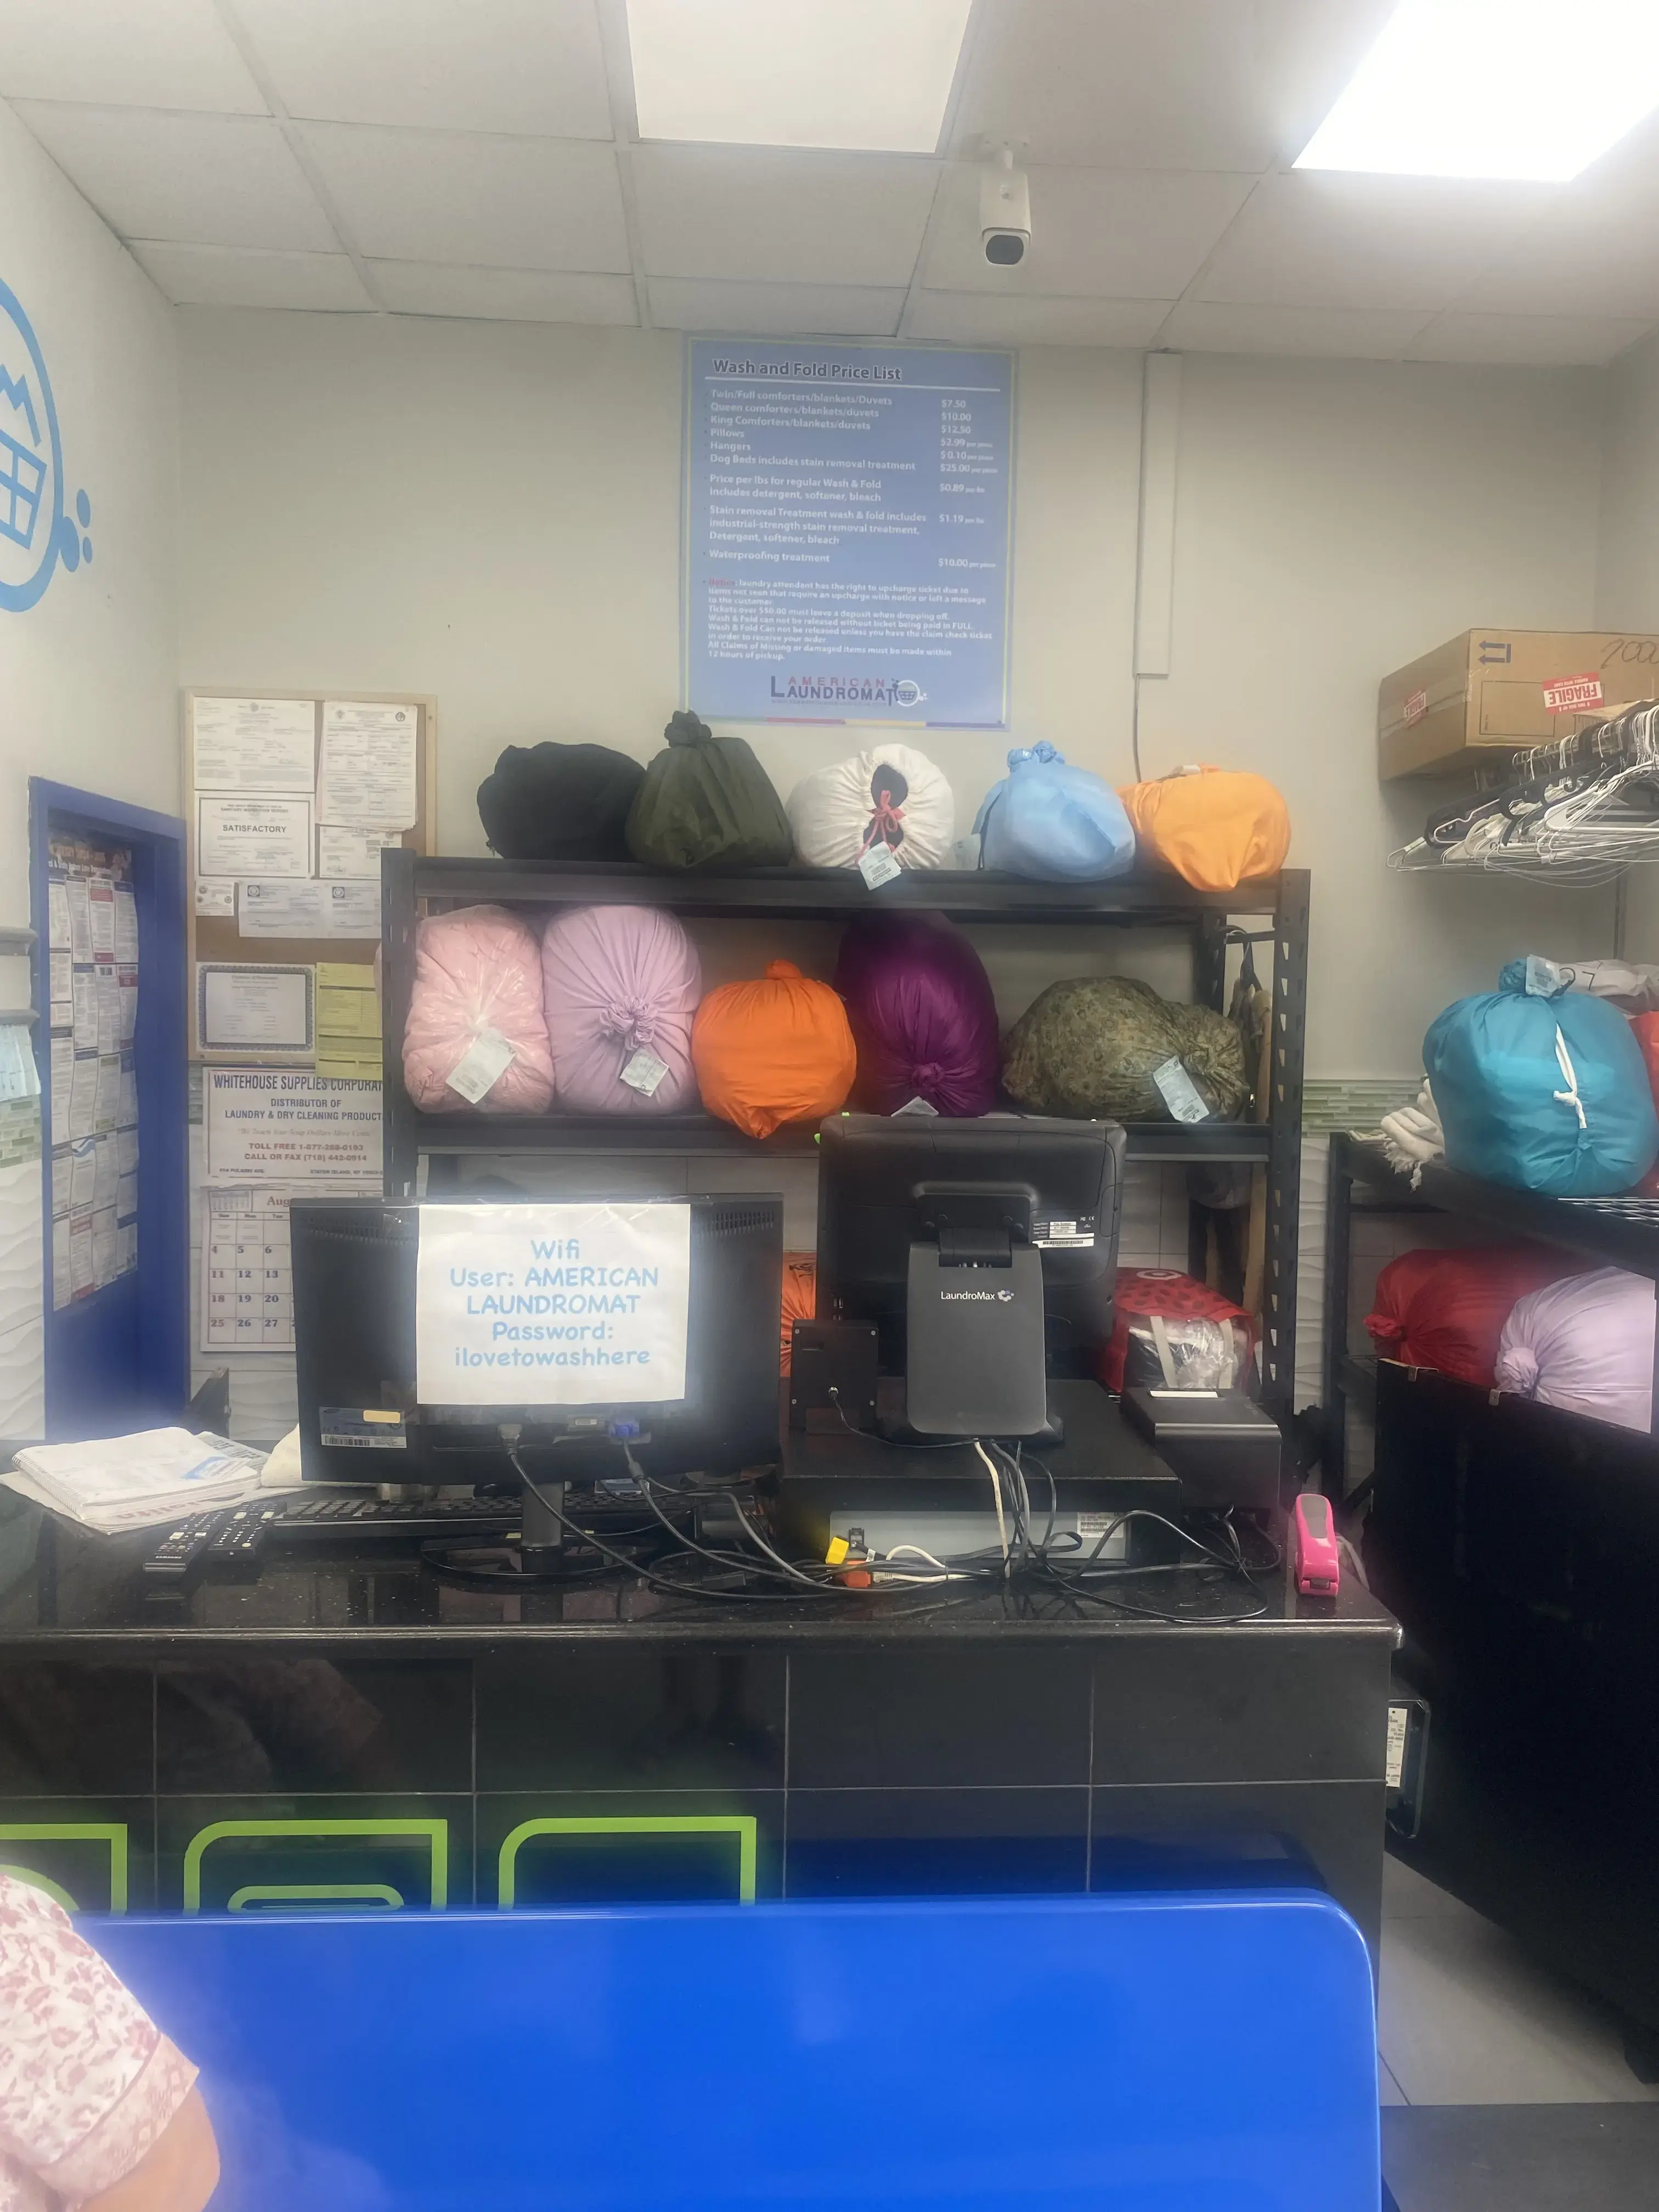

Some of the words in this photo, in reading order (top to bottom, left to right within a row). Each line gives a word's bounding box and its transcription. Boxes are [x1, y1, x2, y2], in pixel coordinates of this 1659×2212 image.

[713, 359, 755, 374] Wash
[759, 362, 789, 375] and
[793, 363, 827, 377] Fold
[831, 364, 870, 379] Price
[873, 366, 901, 380] List
[711, 402, 742, 412] Queen
[941, 399, 966, 408] $7.50
[710, 415, 733, 426] King
[941, 413, 971, 421] $10.00
[710, 428, 744, 438] Pillows
[941, 426, 970, 434] $12.50
[710, 441, 751, 452] Hangers
[941, 438, 965, 447] $2.99
[710, 453, 730, 465] Dog
[733, 454, 755, 464] Beds
[758, 455, 798, 466] includes
[801, 458, 823, 466] stain
[826, 459, 865, 467] removal
[868, 460, 915, 470] treatment
[940, 464, 970, 473] $25.00
[710, 474, 733, 483] Price
[736, 477, 752, 486] per
[755, 476, 768, 485] lbs
[771, 476, 783, 485] for
[786, 477, 821, 488] regular
[823, 478, 848, 488] Wash
[851, 479, 858, 488] &
[860, 479, 881, 488] Fold
[940, 483, 964, 492] $0.89
[752, 488, 802, 500] detergent,
[805, 492, 847, 501] softener,
[849, 492, 881, 501] bleach
[709, 505, 733, 515] Stain
[736, 506, 776, 516] removal
[778, 508, 827, 518] Treatment
[830, 510, 854, 519] wash
[866, 511, 884, 520] fold
[887, 512, 926, 521] includes
[709, 517, 800, 532] industrial-strength
[803, 522, 826, 531] stain
[828, 523, 866, 533] removal
[869, 525, 919, 535] treatment,
[709, 531, 761, 543] Detergent,
[763, 533, 805, 544] softener,
[808, 535, 839, 545] bleach
[709, 549, 780, 562] Waterproofing
[782, 554, 830, 563] treatment
[938, 558, 968, 567] $10.00
[740, 579, 771, 589] laundry
[847, 583, 866, 592] right
[878, 585, 916, 594] upcharge
[832, 592, 870, 601] upcharge
[840, 610, 871, 619] deposit
[897, 612, 934, 621] dropping
[708, 623, 730, 631] Wash
[898, 621, 921, 629] being
[721, 641, 748, 650] Claims
[760, 643, 791, 652] Missing
[804, 644, 842, 653] damaged
[927, 648, 951, 656] within
[755, 652, 786, 661] pickup.
[788, 676, 885, 687] AMERICAN
[771, 675, 894, 707] LAUNDROMAT
[1548, 684, 1598, 705] FRAGILE
[223, 825, 286, 833] SATISFACTORY
[214, 1075, 278, 1089] WHITEHOUSE
[281, 1076, 327, 1090] SUPPLIES
[271, 1098, 328, 1108] DISTRIBUTOR
[330, 1099, 342, 1108] OF
[225, 1110, 265, 1119] LAUNDRY
[297, 1111, 338, 1120] CLEANING
[211, 1245, 217, 1254] 4
[238, 1245, 244, 1254] 5
[265, 1245, 272, 1254] 6
[530, 1238, 579, 1260] Wifi
[450, 1267, 514, 1287] User:
[524, 1266, 658, 1287] AMERICAN
[941, 1291, 995, 1300] LaundroMax
[467, 1294, 641, 1315] LAUNDROMAT
[492, 1321, 613, 1341] Password:
[455, 1347, 650, 1367] ilovetowashhere
